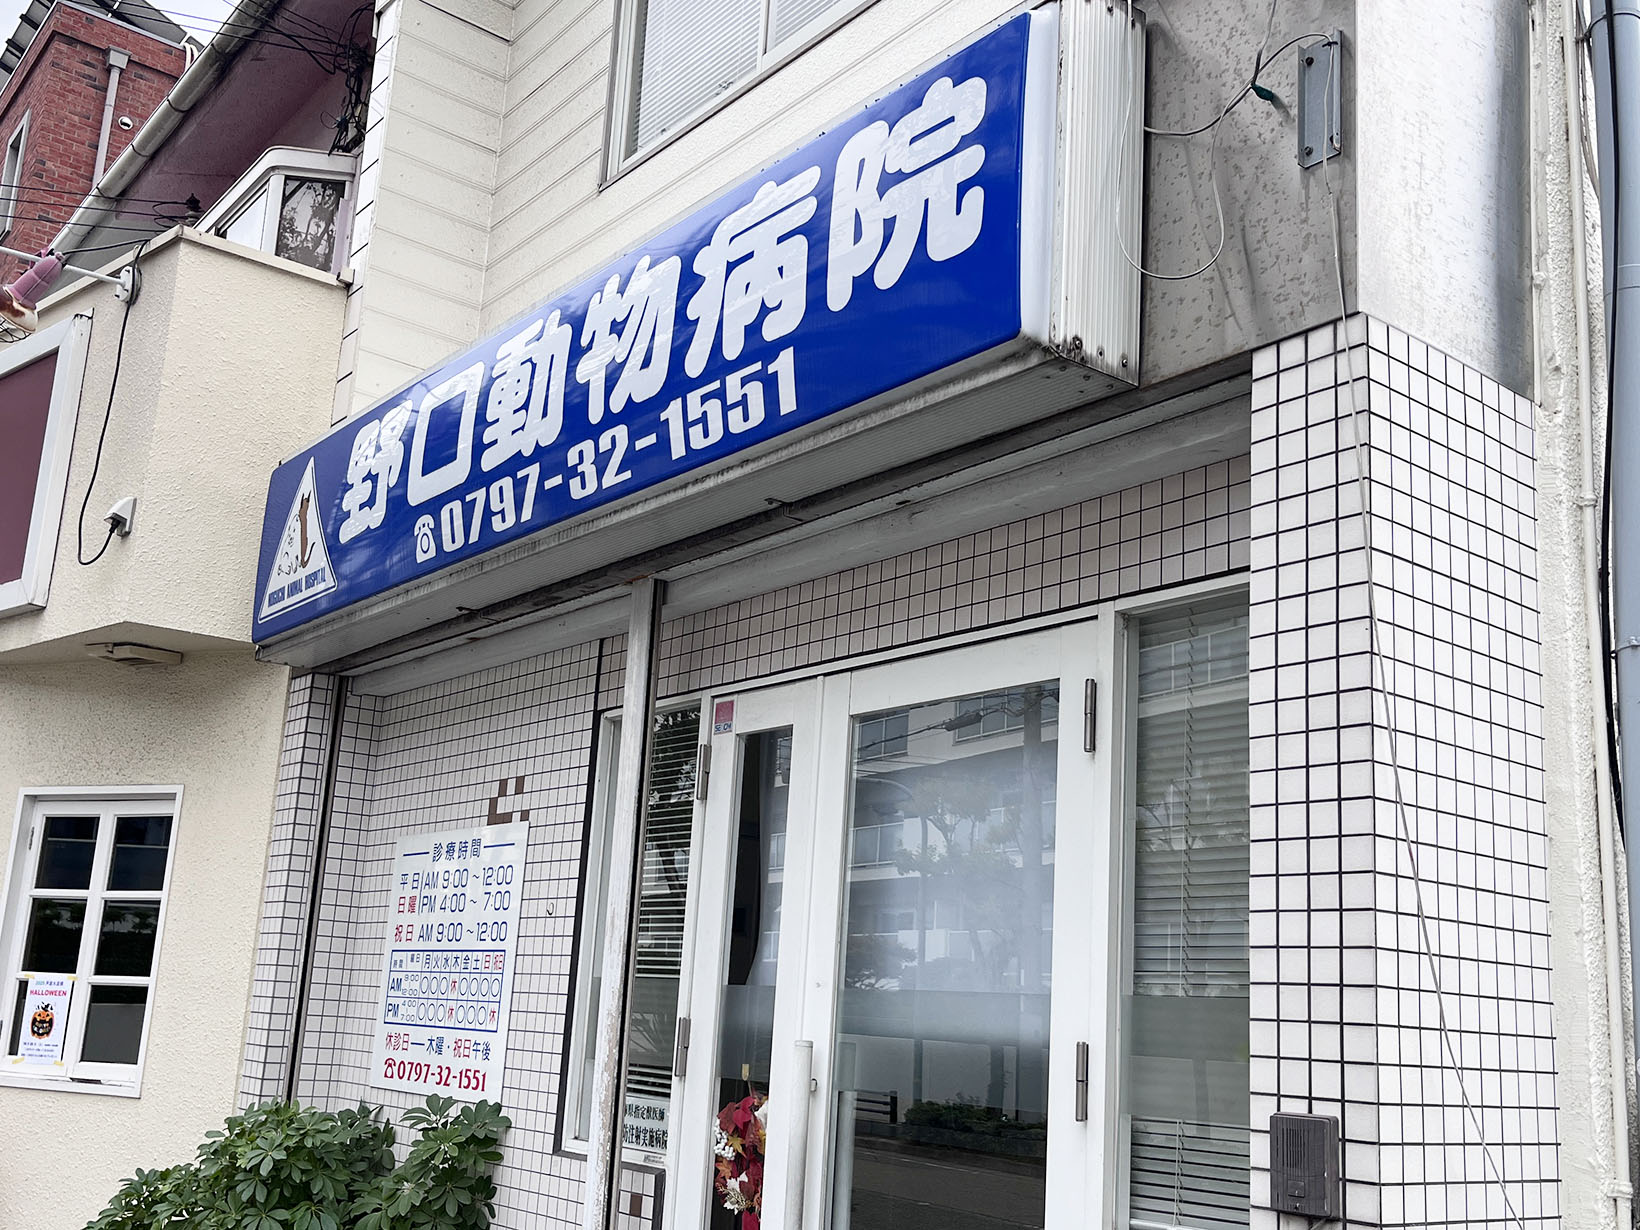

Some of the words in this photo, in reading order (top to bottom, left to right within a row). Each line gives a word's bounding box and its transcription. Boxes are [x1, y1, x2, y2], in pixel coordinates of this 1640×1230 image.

[339, 76, 986, 544] 野口動物病院
[440, 347, 799, 550] 0797-32-1551
[432, 838, 482, 863] 診療時間
[399, 872, 420, 891] 平日
[424, 870, 440, 890] AM
[397, 895, 418, 914] 日曜
[421, 895, 437, 913] PM
[394, 923, 415, 943] 祝日
[418, 923, 433, 943] AM
[423, 954, 431, 969] 月
[432, 955, 441, 969] 火
[442, 954, 450, 970] 水
[452, 954, 460, 970] 木
[462, 954, 470, 970] 金
[472, 955, 480, 970] 土
[483, 954, 491, 970] 日
[30, 989, 67, 997] HALLOWEEN
[389, 977, 402, 992] AM
[450, 979, 457, 994] 休
[386, 1003, 399, 1018] PM
[447, 1007, 454, 1022] 休
[488, 1008, 496, 1024] 休
[397, 1060, 487, 1092] 0797-32-1551
